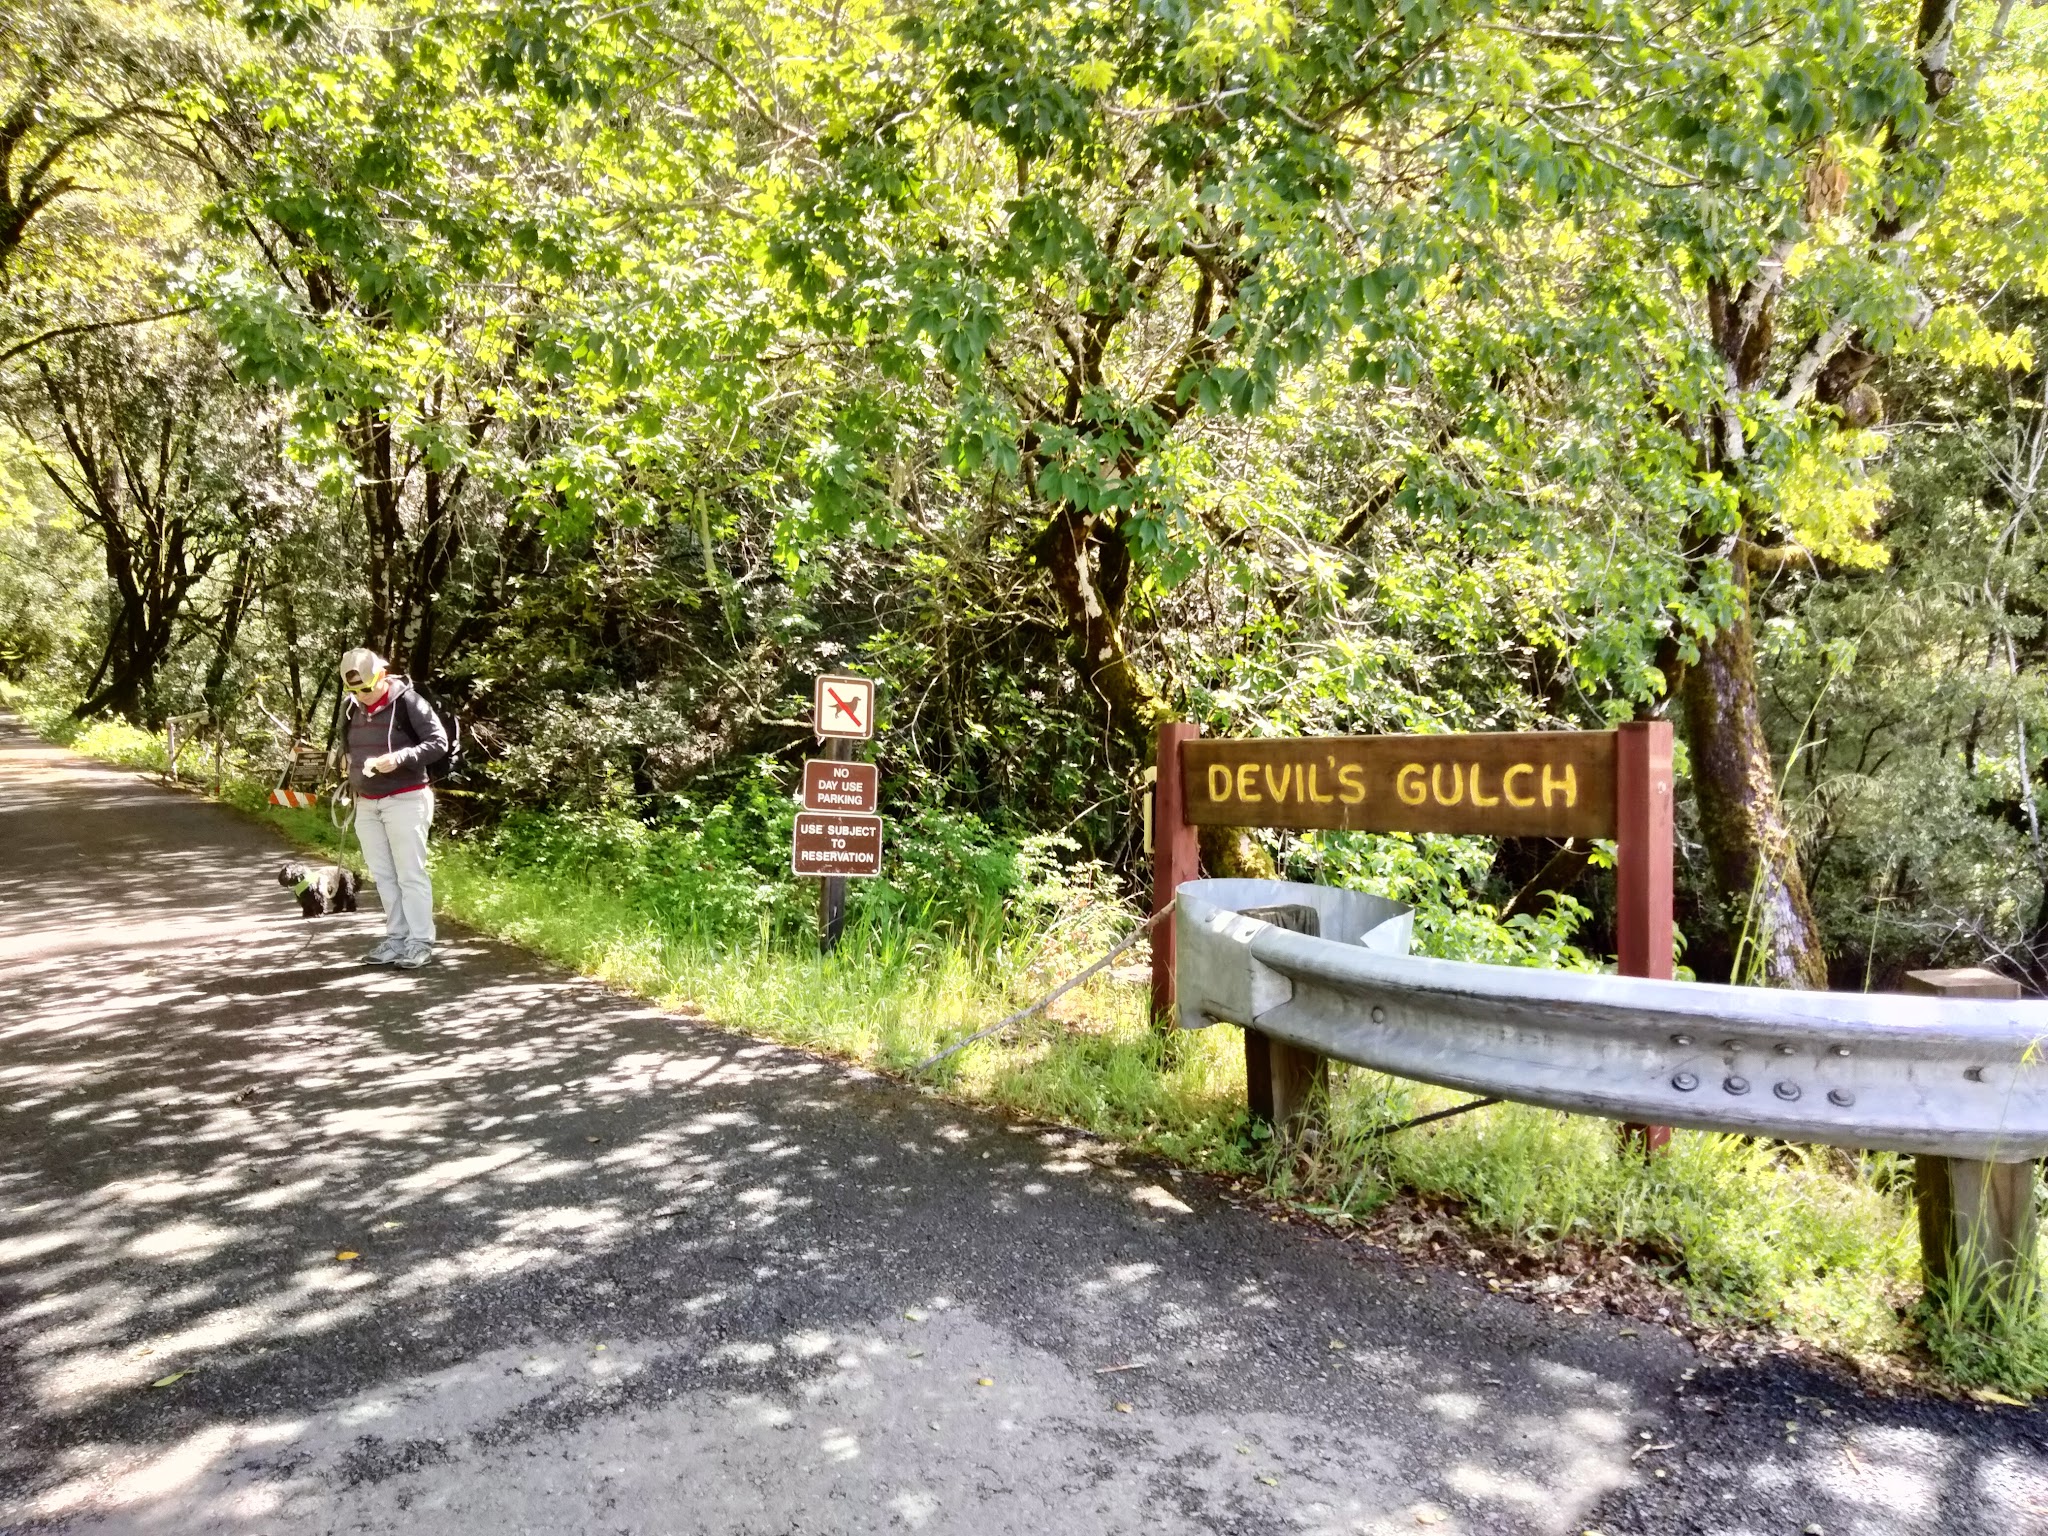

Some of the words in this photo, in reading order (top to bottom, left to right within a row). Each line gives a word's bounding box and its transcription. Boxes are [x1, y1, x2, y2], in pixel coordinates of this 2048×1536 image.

[833, 767, 850, 778] NO
[818, 780, 838, 790] DAY
[842, 782, 863, 792] USE
[1208, 755, 1366, 804] DEVIL'S
[1396, 762, 1578, 808] GULCH
[817, 793, 863, 805] PARKING
[800, 824, 823, 834] USE
[827, 825, 877, 837] SUBJECT
[831, 839, 846, 849] TO
[801, 851, 874, 863] RESERVATION
